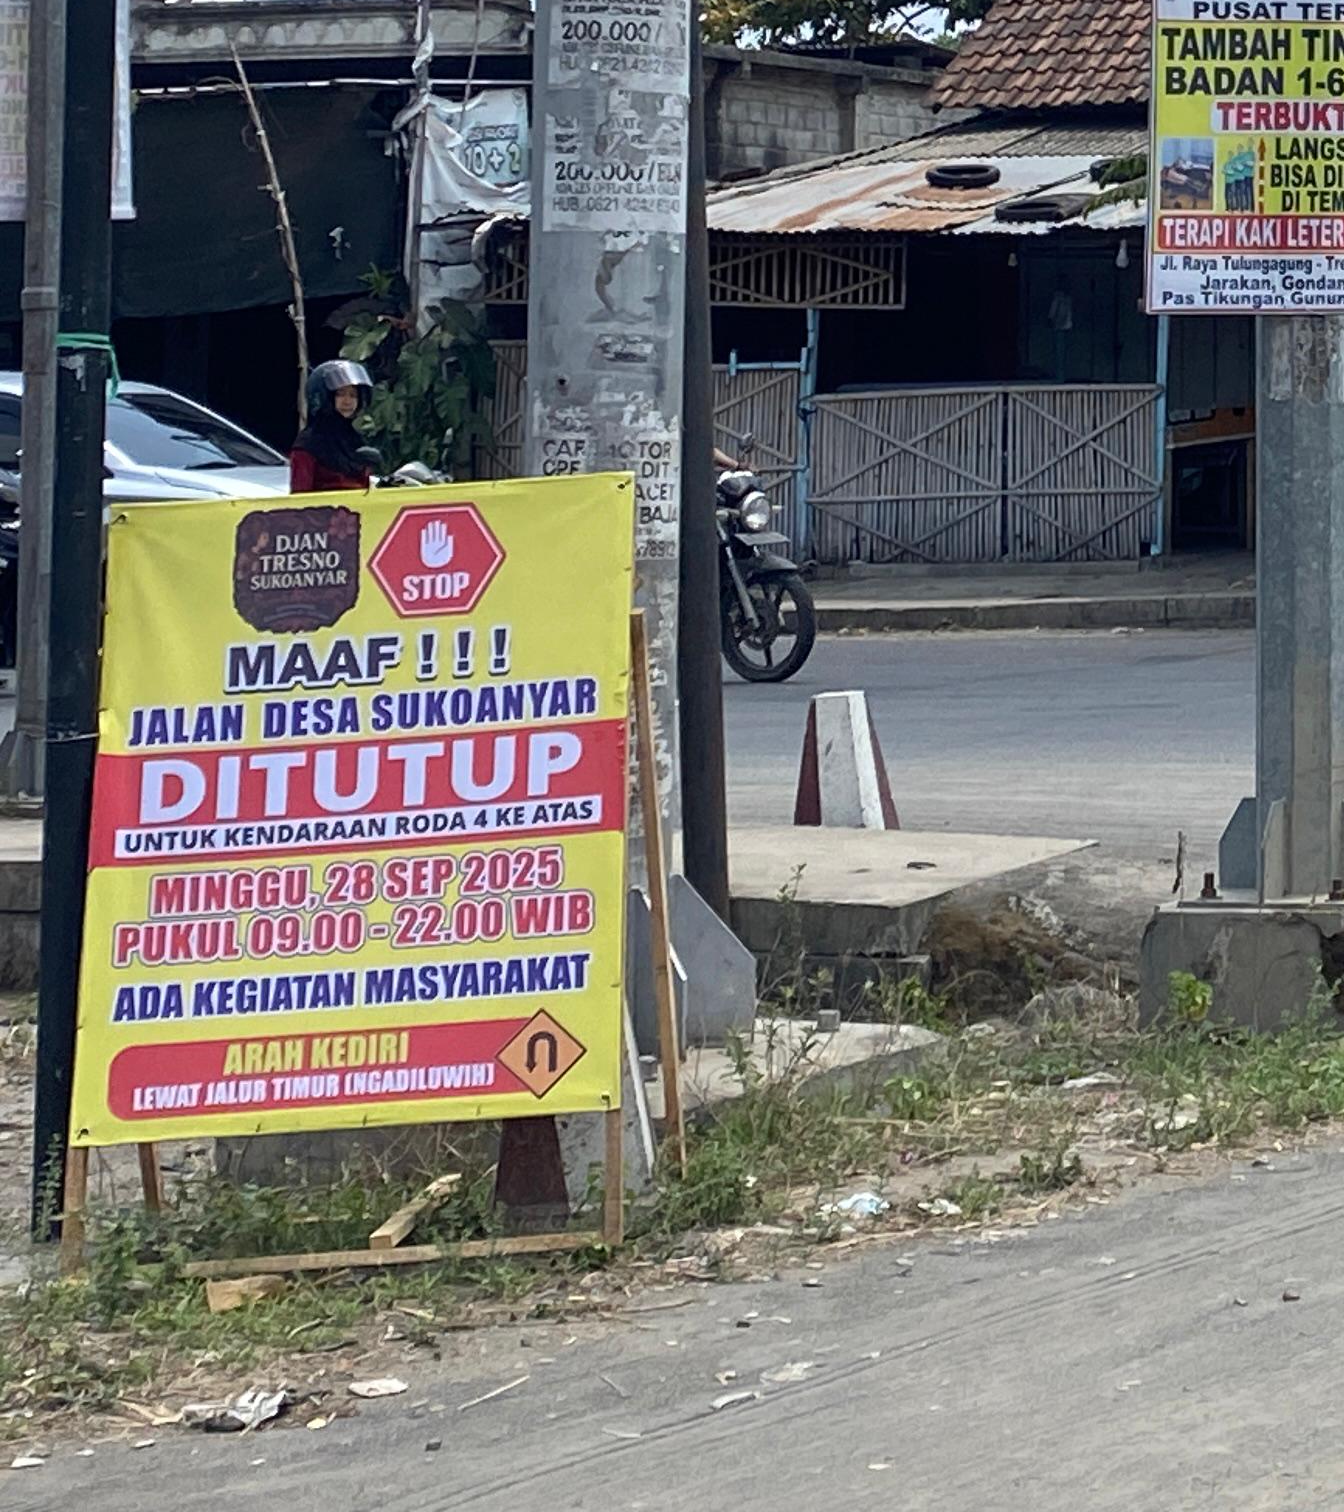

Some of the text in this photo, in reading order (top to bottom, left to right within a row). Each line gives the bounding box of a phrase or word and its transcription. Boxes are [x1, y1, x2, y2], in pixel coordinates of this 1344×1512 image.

[1193, 1, 1288, 20] PUSAT
[1161, 28, 1292, 62] TAMBAH
[1165, 66, 1284, 96] BADAN
[1270, 165, 1318, 189] BISA
[1281, 191, 1302, 213] DI
[1163, 219, 1229, 247] TERAPI
[1235, 219, 1281, 247] KAKI
[1287, 219, 1343, 248] LETER
[1182, 256, 1218, 274] Raya
[1222, 256, 1313, 275] Tulungagung
[1162, 291, 1195, 305] Pas
[1200, 276, 1277, 293] Jarakan,
[275, 532, 328, 552] DJAN
[259, 551, 340, 573] TRESNO
[251, 569, 348, 590] SUKOANYAR
[402, 571, 470, 602] STOP
[228, 636, 400, 688] MAAF
[128, 678, 598, 746] JALAN DESA SUKOANYAR
[139, 731, 583, 825] DITUTUP
[124, 799, 594, 855] UNTUK KENDARAAN RODA 4 KE ATAS
[152, 847, 561, 916] MINGGU, 28 SEP 2025
[113, 891, 593, 965] PUKUL 09.00 22.00 WIB
[112, 954, 591, 1022] ADA KEGIATAN MASYARAKAT
[223, 1031, 410, 1077] ARAH KEDIRI
[132, 1082, 201, 1112] LEWAT
[204, 1077, 267, 1106] JALUR
[271, 1073, 340, 1101] TIMUR
